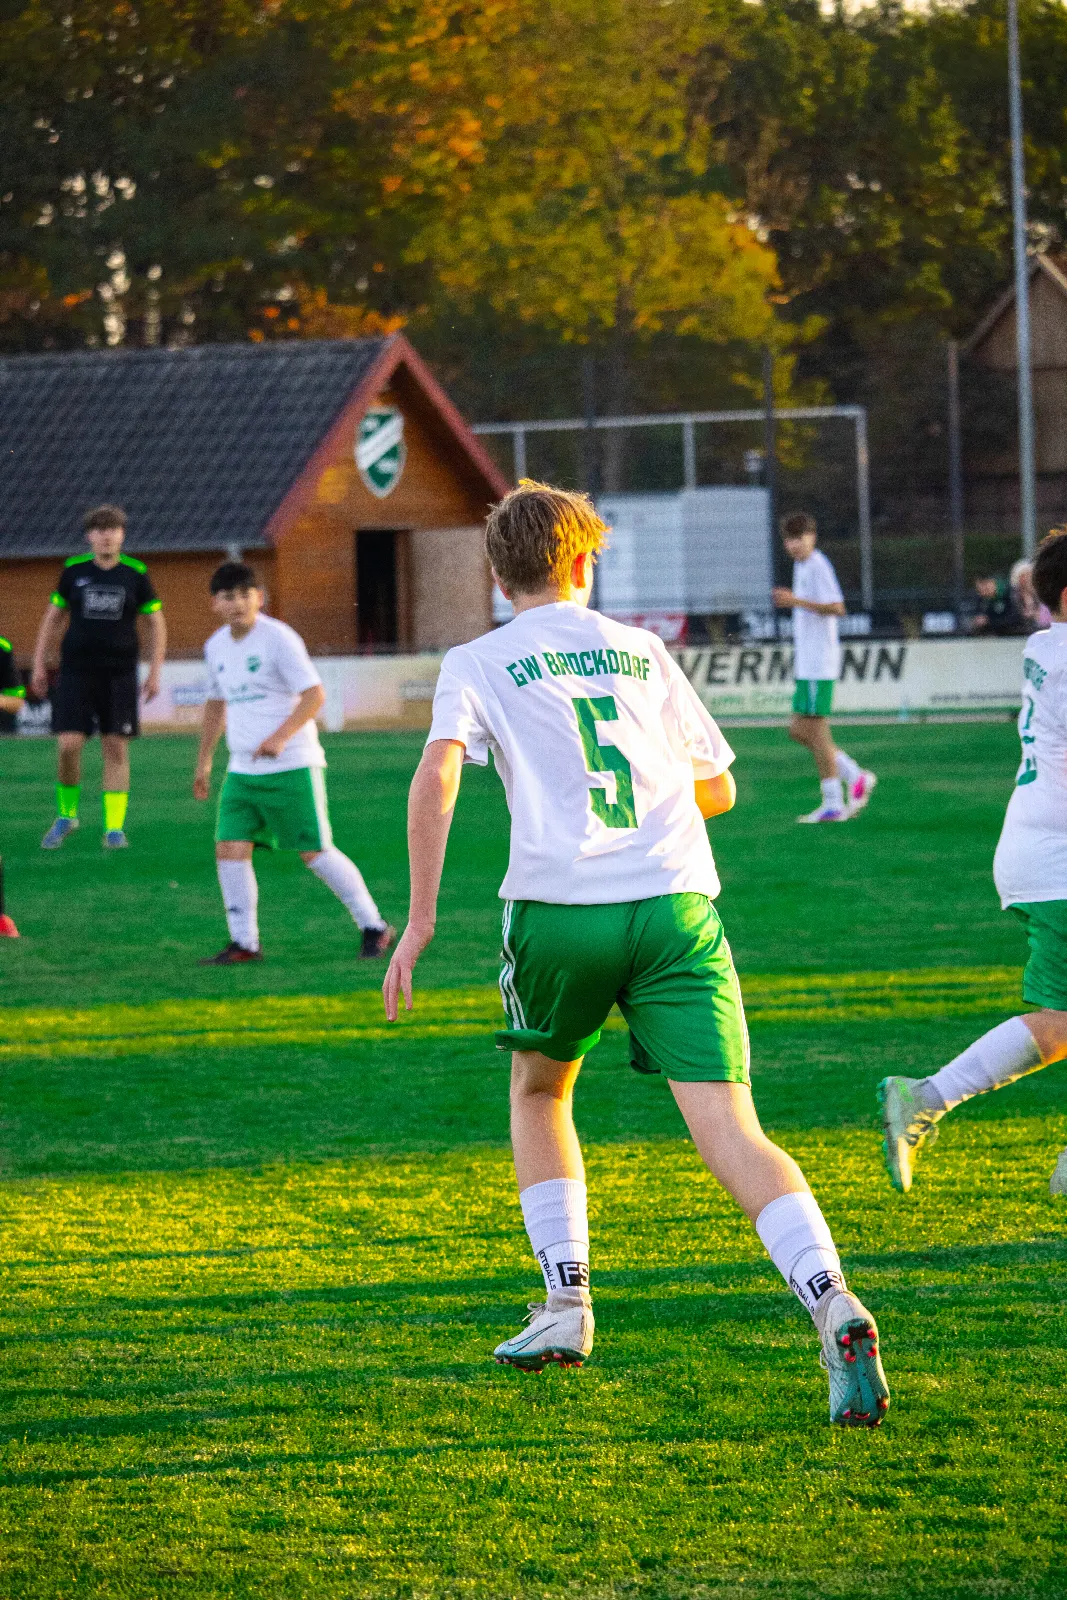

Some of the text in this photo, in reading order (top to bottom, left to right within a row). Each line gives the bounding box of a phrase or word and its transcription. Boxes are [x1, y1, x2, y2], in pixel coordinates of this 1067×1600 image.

[506, 649, 650, 687] GW BROCKDORF
[678, 646, 906, 684] VERMNN
[571, 695, 638, 829] 5
[561, 1263, 588, 1286] FS
